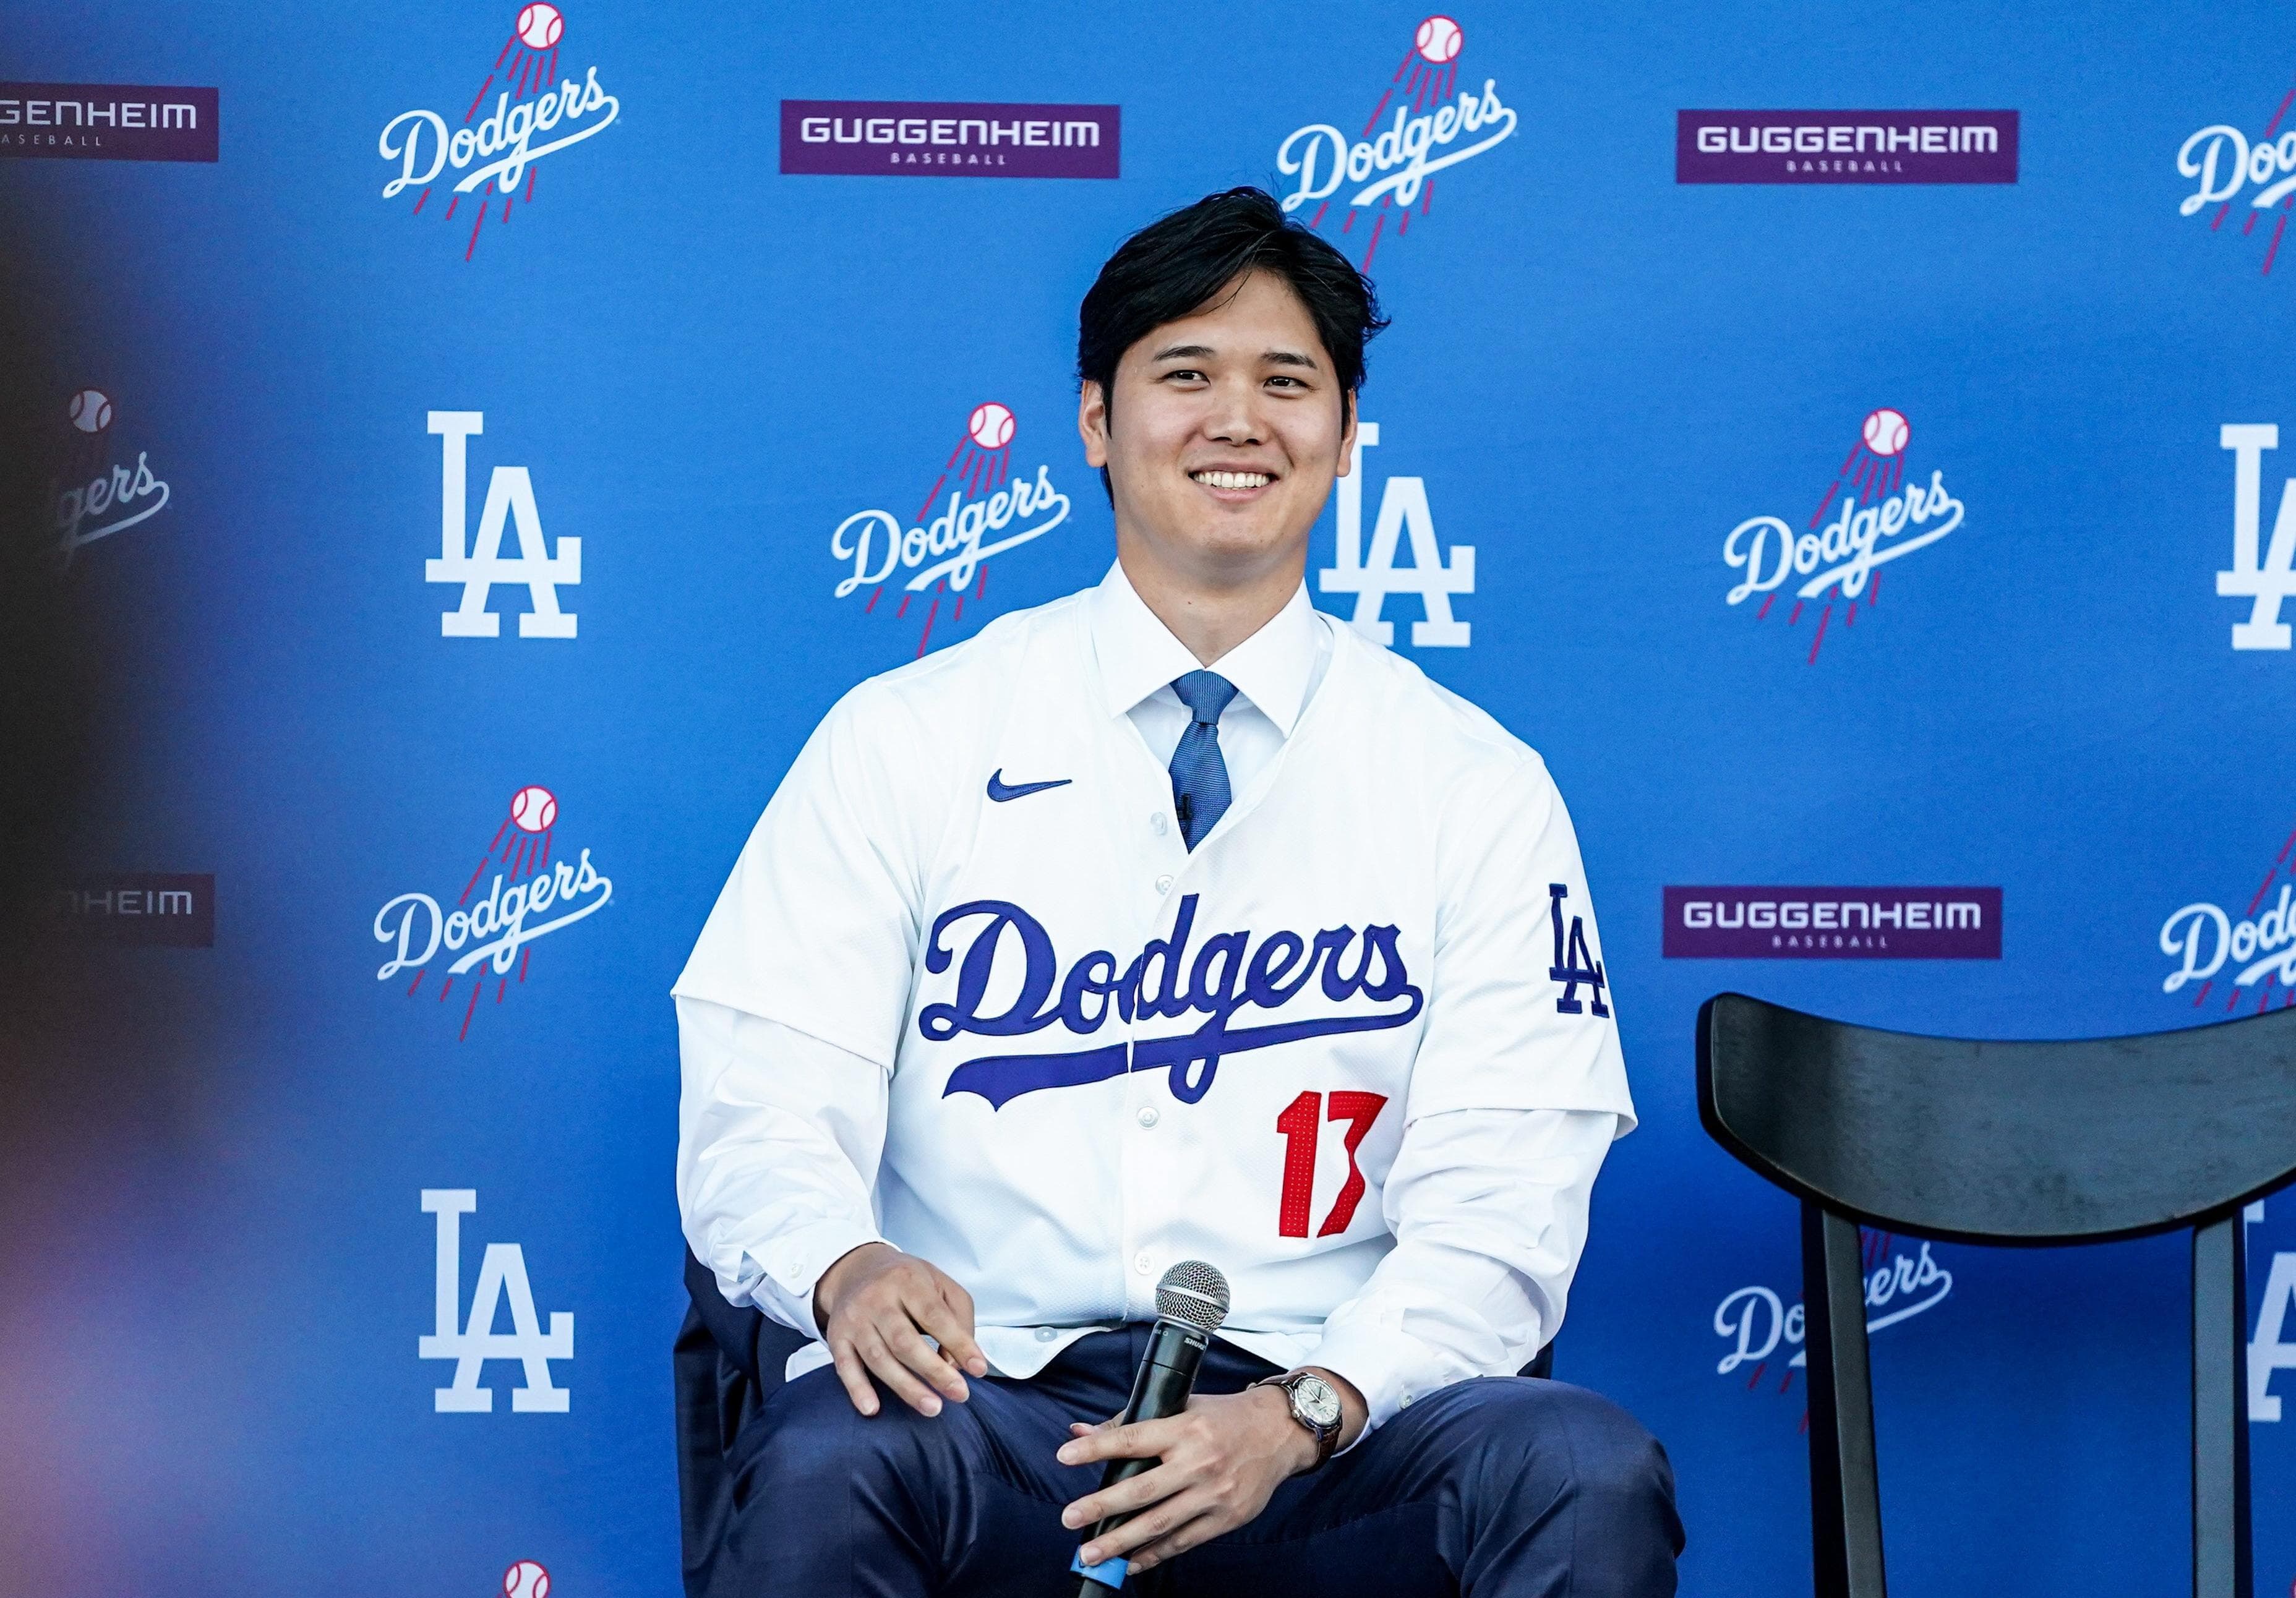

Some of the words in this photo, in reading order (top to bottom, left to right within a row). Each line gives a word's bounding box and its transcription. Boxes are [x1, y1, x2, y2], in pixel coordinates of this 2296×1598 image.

[379, 66, 620, 199] Dodgers
[801, 117, 1100, 147] GUGGENHEIM
[889, 152, 1006, 166] BASEBALL
[1277, 79, 1517, 213] Dodgers
[1697, 126, 1998, 153] GUGGENHEIM
[1786, 159, 1903, 174] BASEBALL
[425, 411, 582, 639] LA
[831, 464, 1071, 599] Dodgers
[1319, 422, 1476, 647] LA
[1723, 469, 1965, 605] Dodgers
[374, 848, 612, 981] Dodgers
[1549, 882, 1610, 1019] LA
[1683, 901, 1982, 929] GUGGENHEIM
[1772, 934, 1888, 949] BASEBALL
[919, 893, 1424, 1112] Dodgers
[1275, 1090, 1389, 1239] 17
[419, 1189, 575, 1413] LA
[1713, 1241, 1953, 1375] Doers
